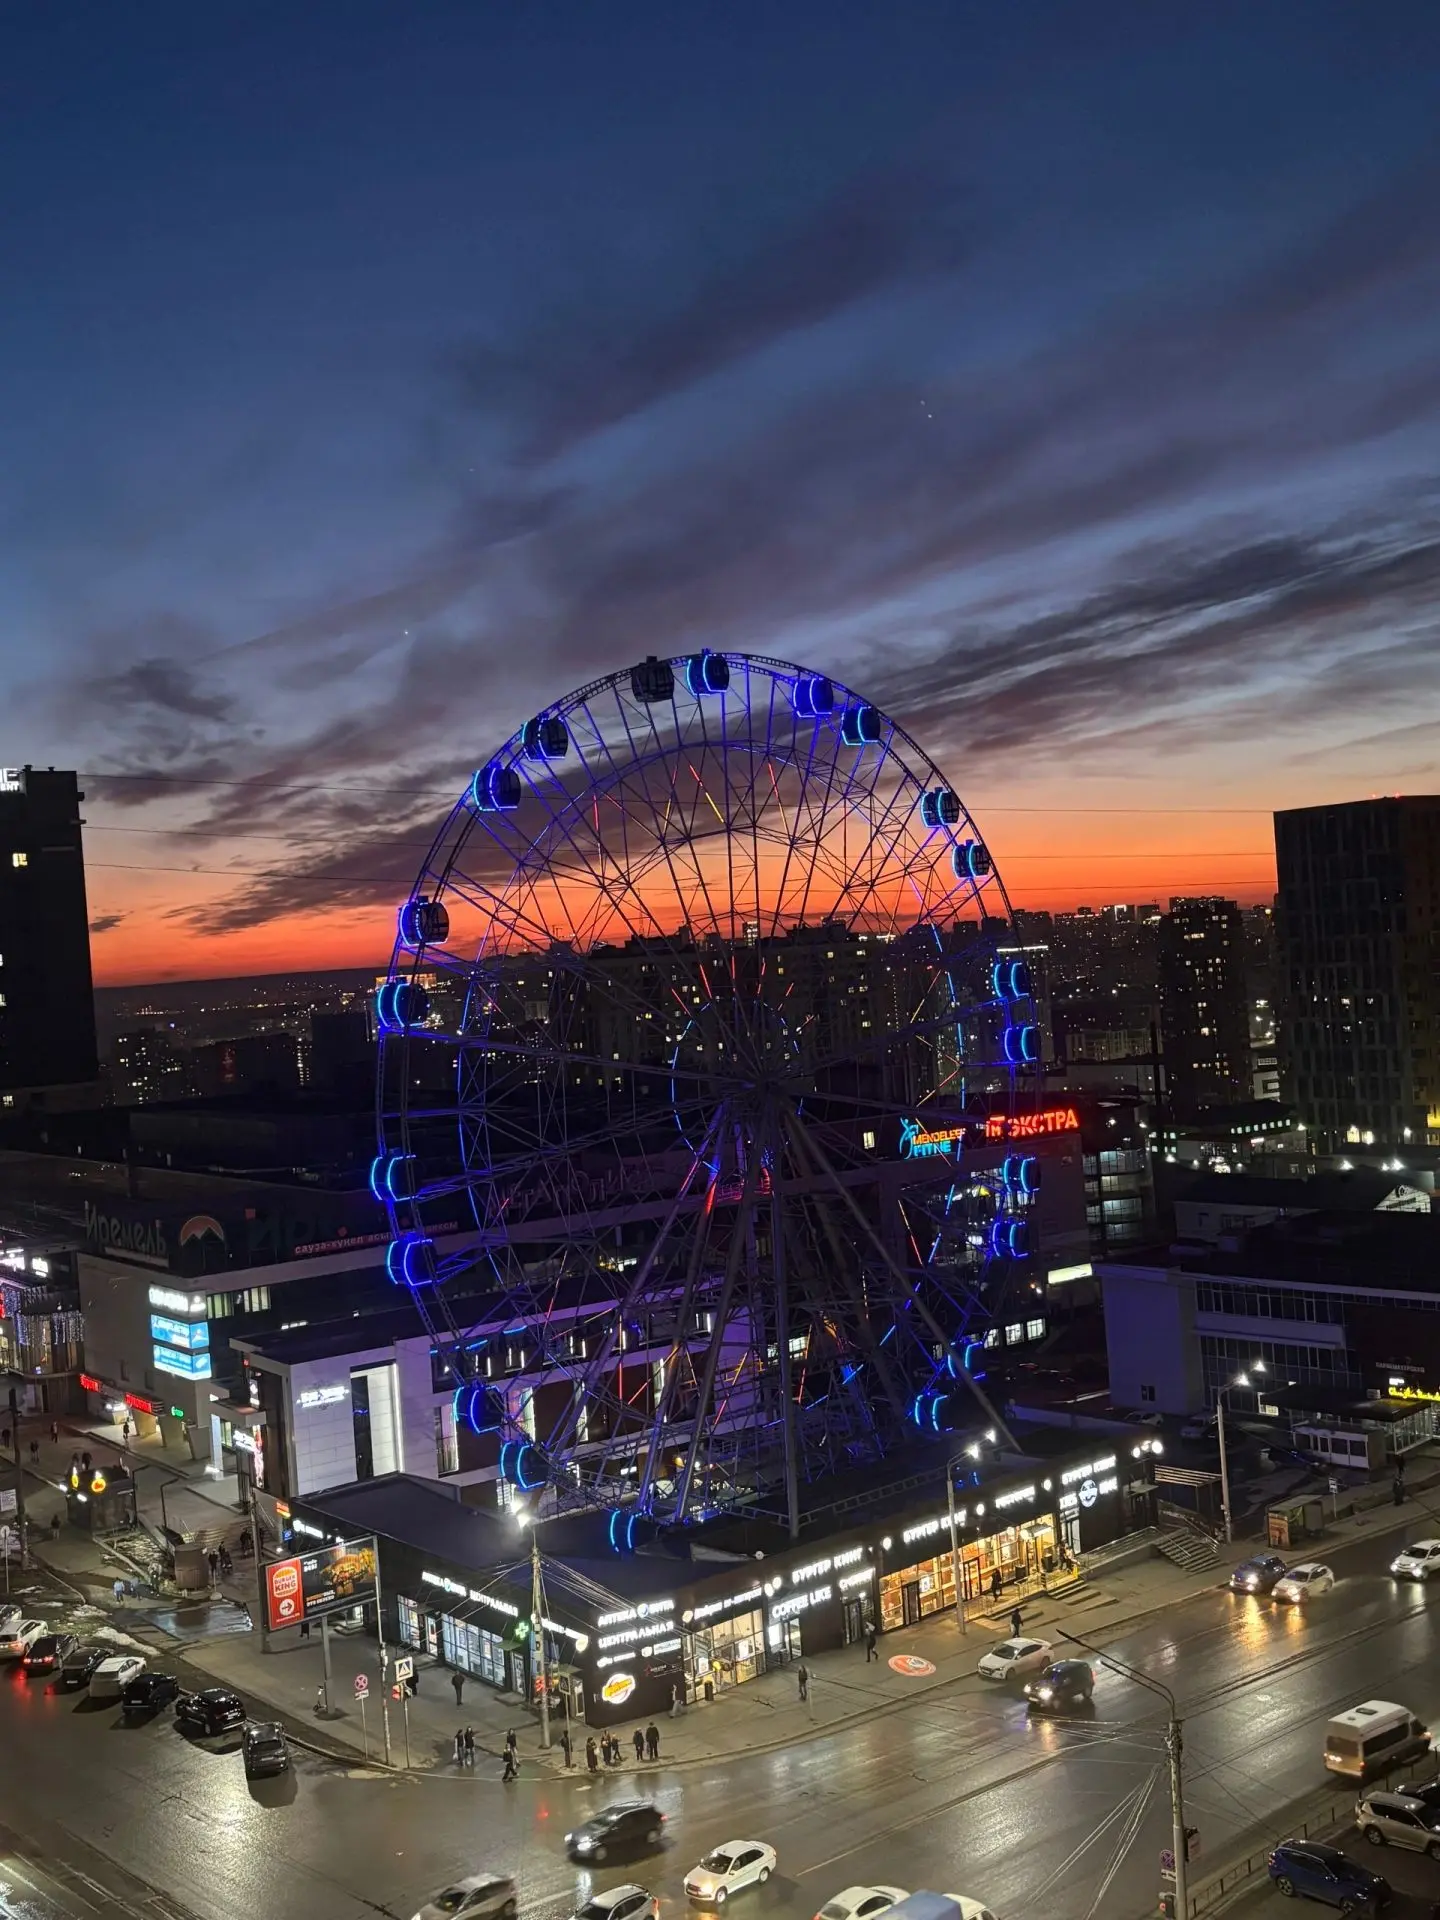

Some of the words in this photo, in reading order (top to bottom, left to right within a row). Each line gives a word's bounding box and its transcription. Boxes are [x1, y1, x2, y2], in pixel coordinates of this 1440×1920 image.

[1007, 1108, 1078, 1137] ЭКСТРА
[84, 1199, 167, 1257] Иремель
[792, 1559, 832, 1584] БУРГЕР
[275, 1580, 297, 1593] KING
[809, 1585, 832, 1606] LIKE
[597, 1608, 637, 1628] АПТЕКА
[598, 1620, 674, 1649] ЦЕНТРАЛЬНАЯ
